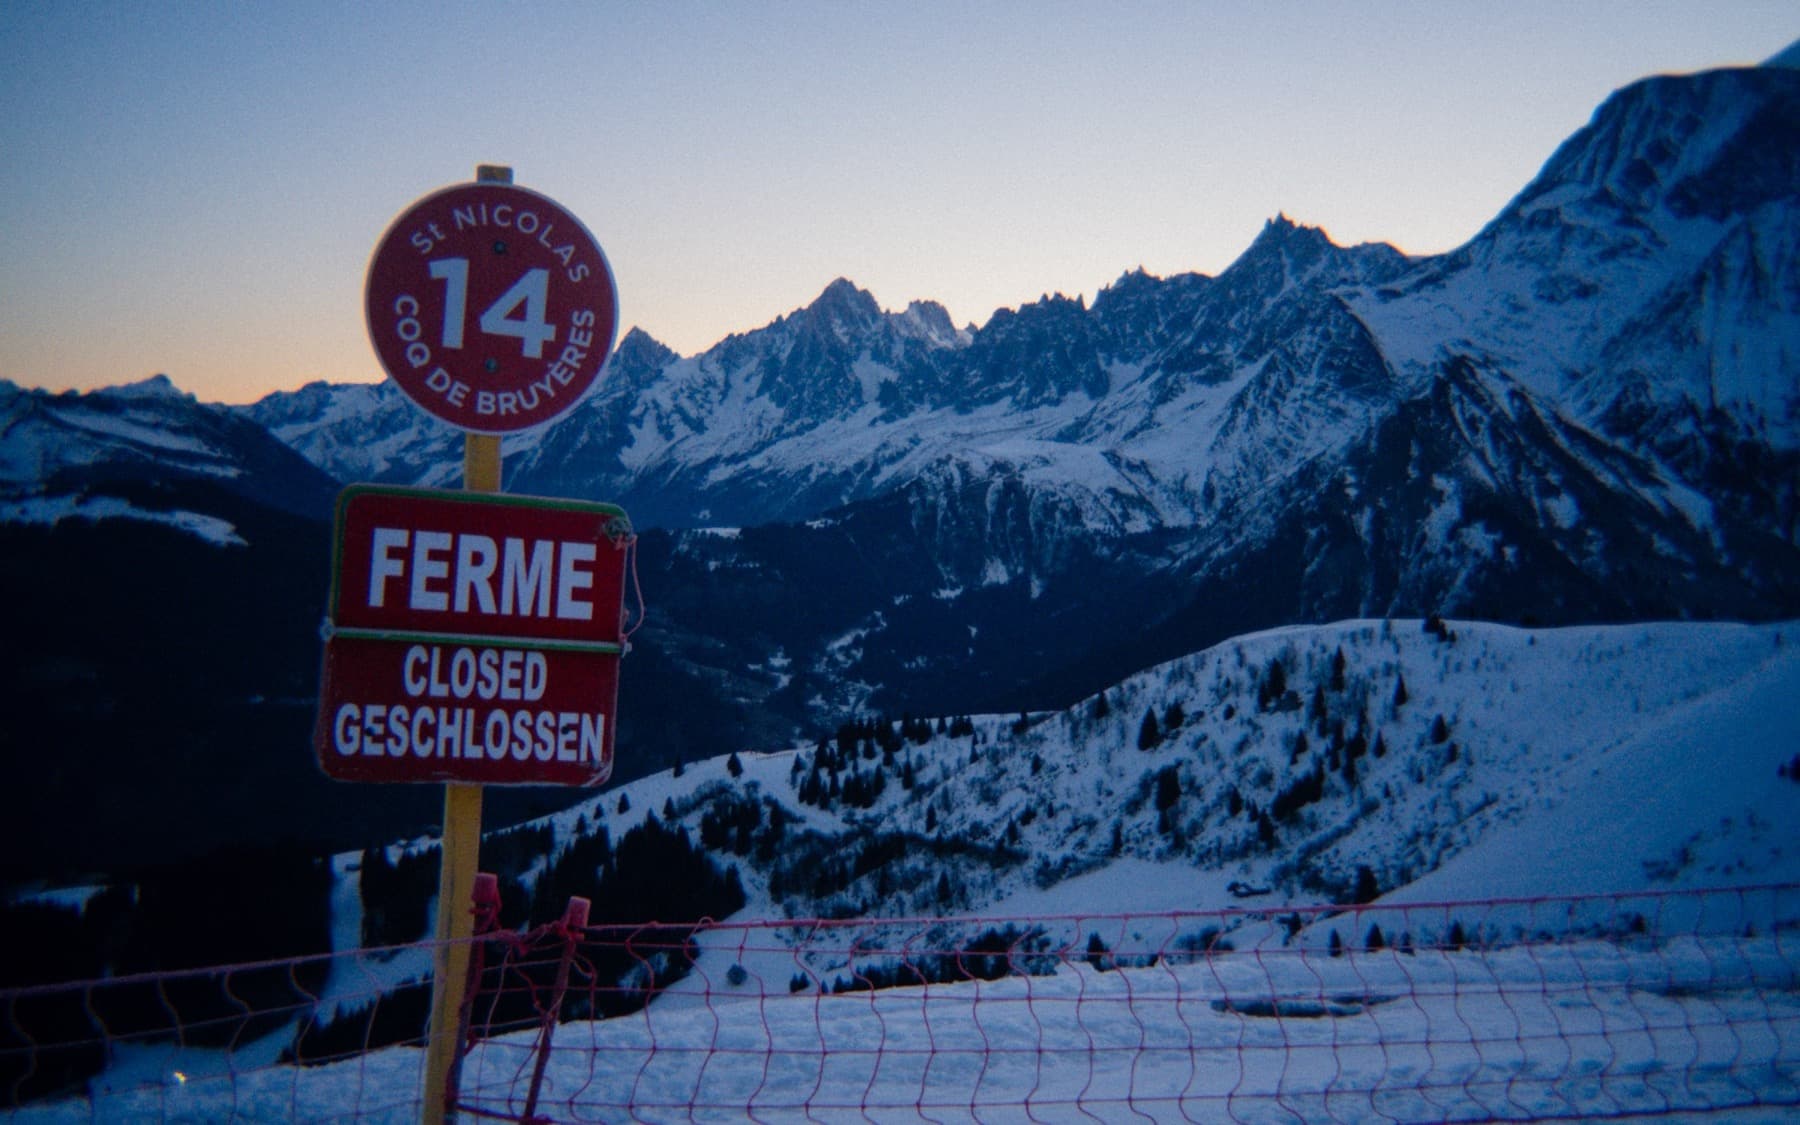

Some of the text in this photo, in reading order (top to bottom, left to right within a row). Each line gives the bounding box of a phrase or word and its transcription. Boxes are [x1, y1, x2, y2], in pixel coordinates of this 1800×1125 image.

[411, 204, 590, 282] St NICOLAS
[428, 257, 556, 359] 14
[395, 295, 596, 416] COQ DE BRUYÈRES
[368, 527, 597, 620] FERME
[404, 645, 548, 702] CLOSED
[334, 703, 605, 763] GESCHLOSSEN
